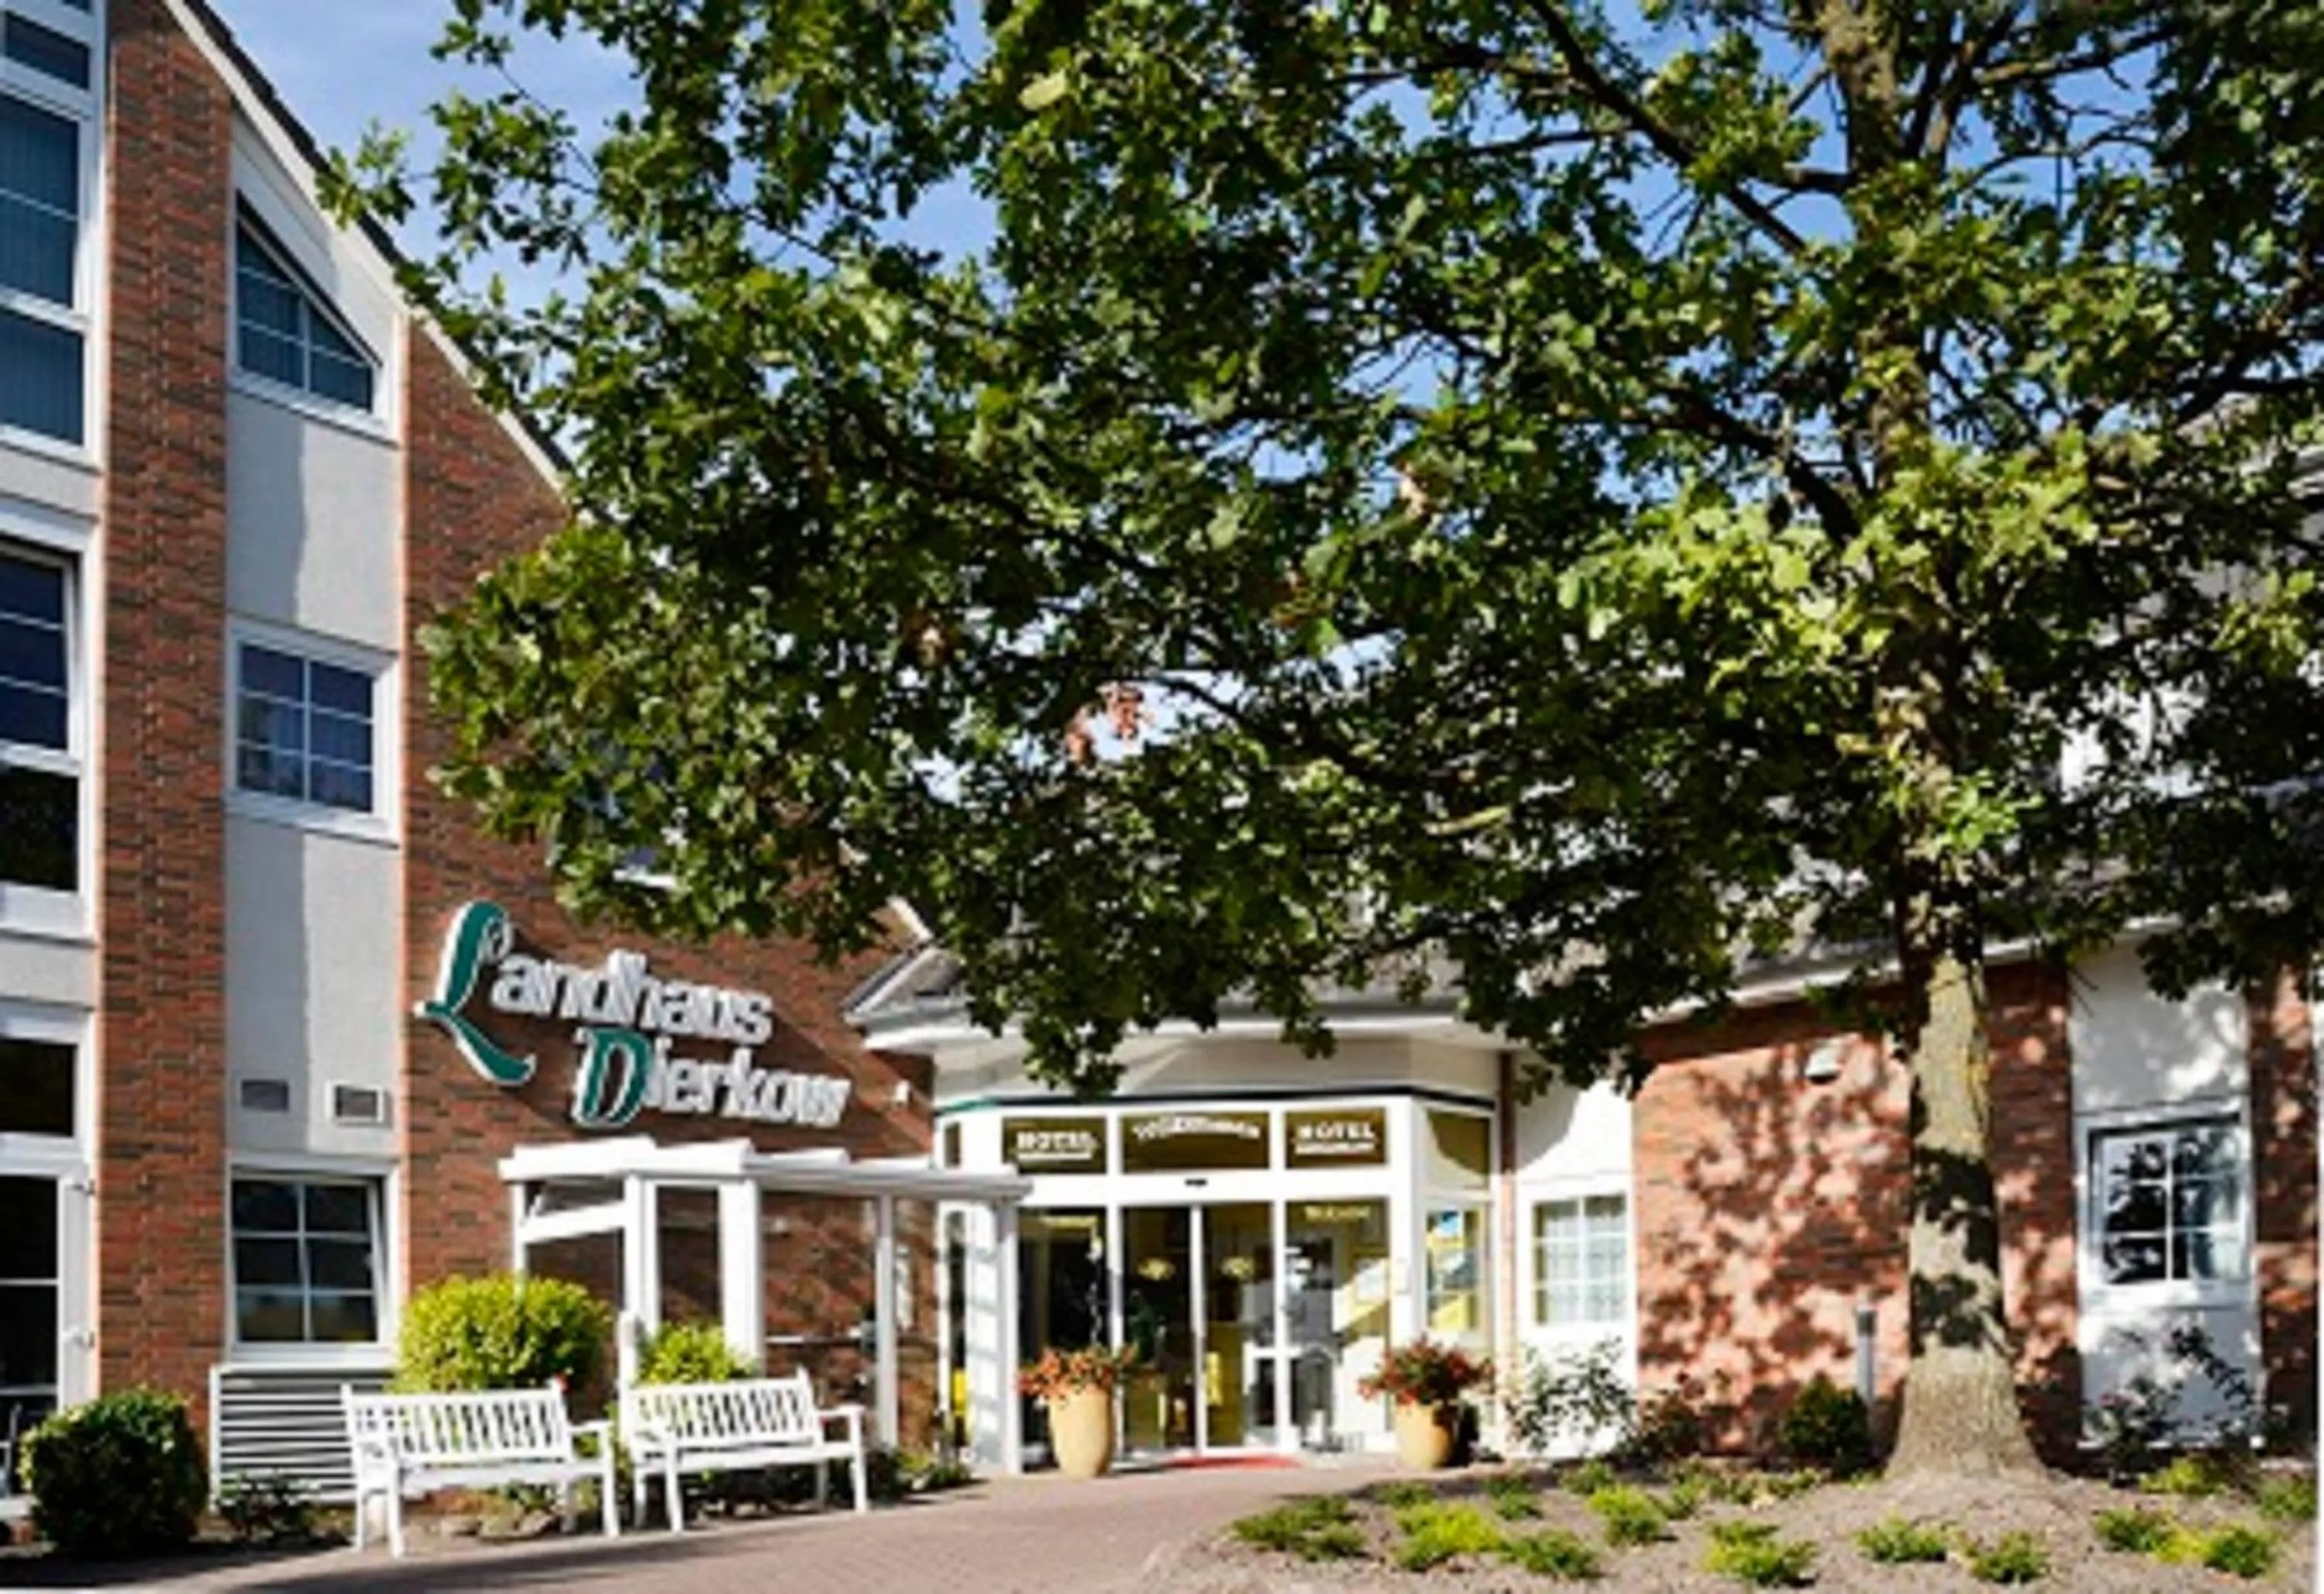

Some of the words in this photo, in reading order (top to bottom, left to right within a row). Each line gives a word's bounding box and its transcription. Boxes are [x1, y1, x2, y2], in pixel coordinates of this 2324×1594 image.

[413, 899, 772, 1084] Landhaus
[571, 1025, 851, 1129] Dierkow
[1297, 1121, 1376, 1140] HOTEL
